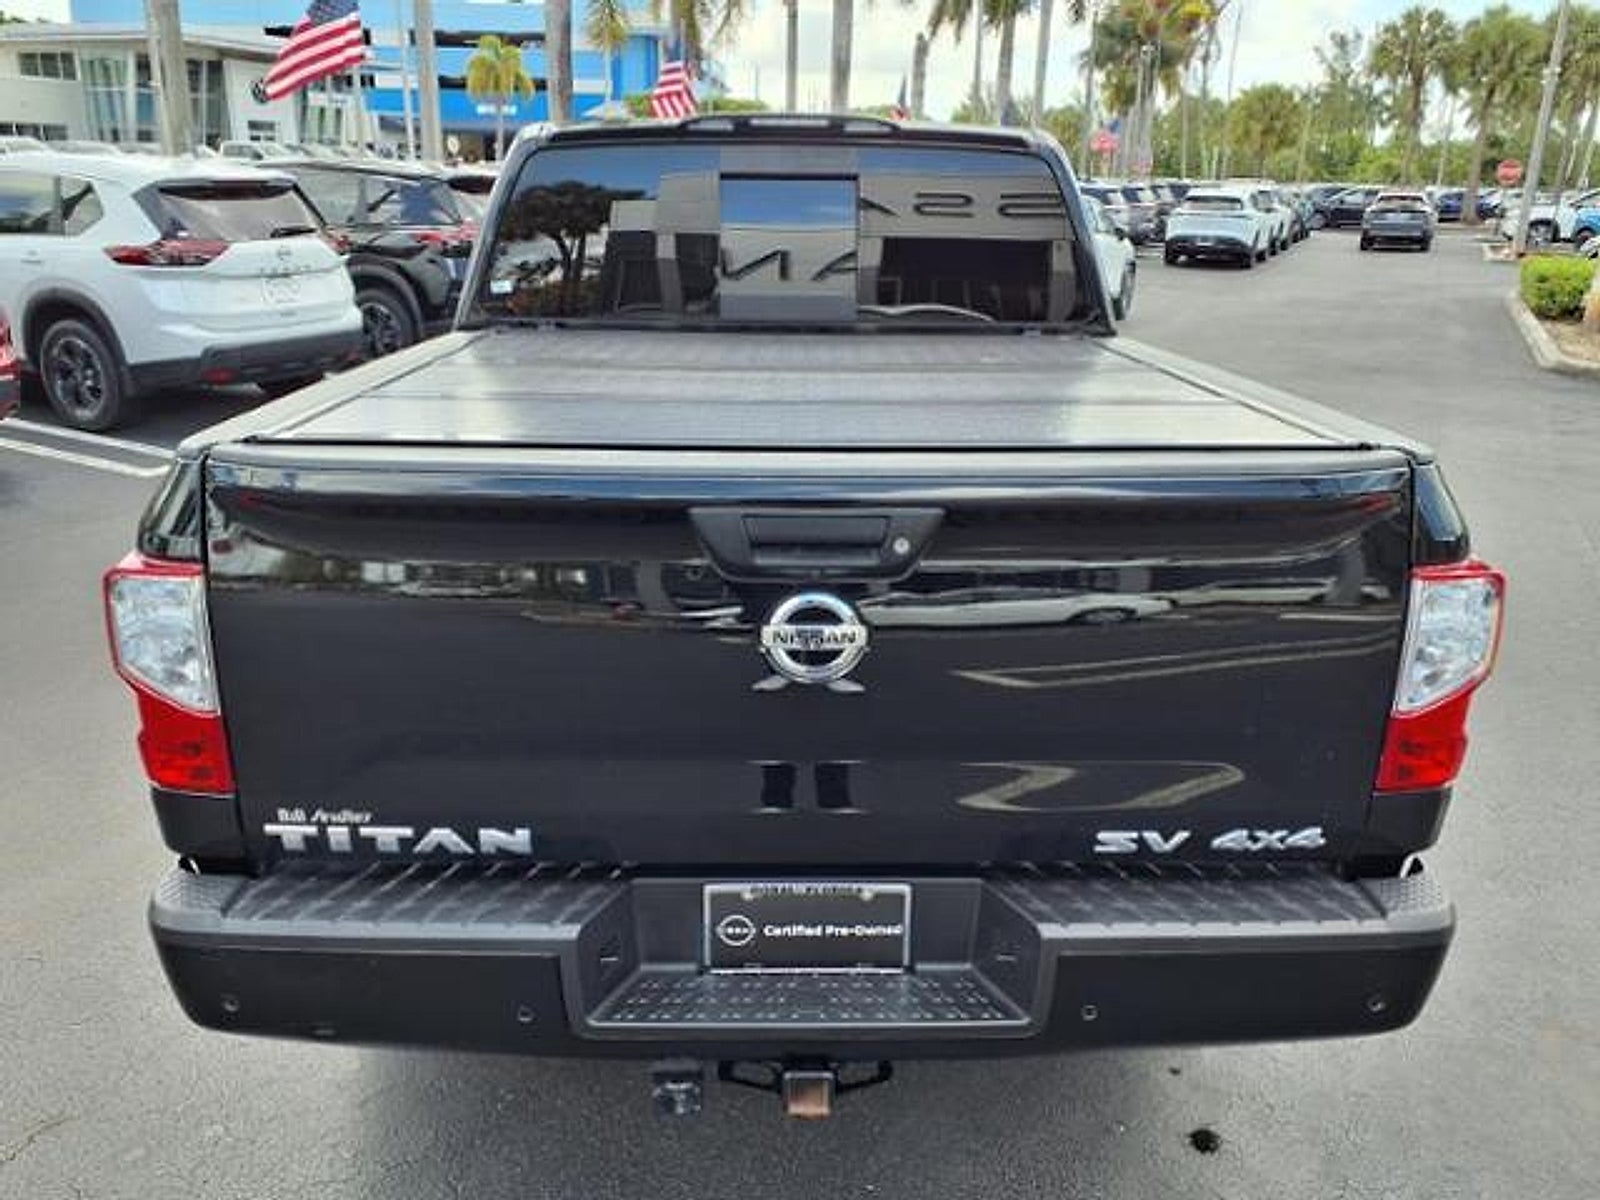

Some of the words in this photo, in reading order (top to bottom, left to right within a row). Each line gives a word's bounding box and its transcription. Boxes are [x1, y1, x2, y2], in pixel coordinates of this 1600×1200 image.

[771, 630, 857, 645] NISSAN
[263, 823, 532, 855] TITAN
[1093, 830, 1192, 853] SV
[763, 924, 822, 937] Certified
[824, 924, 904, 937] Pre-Owned
